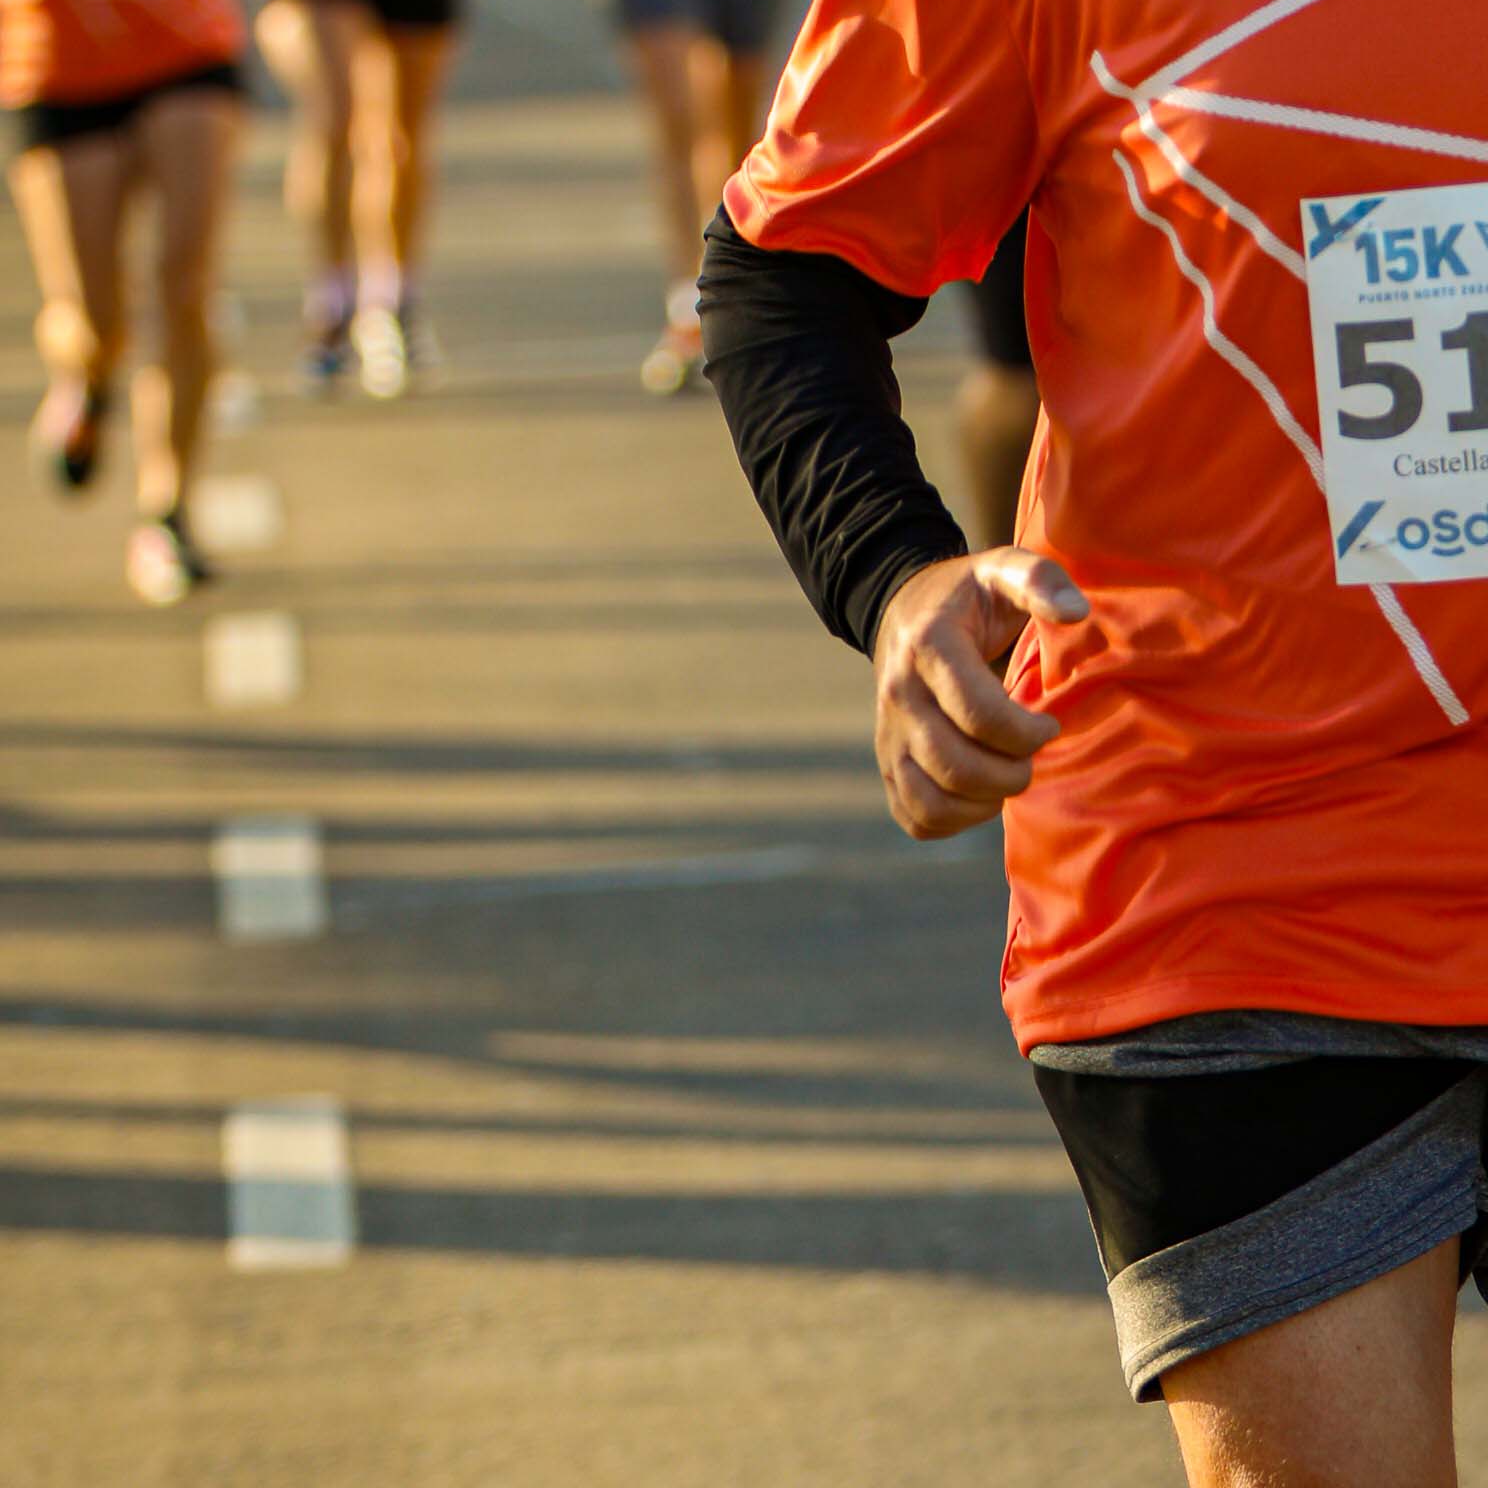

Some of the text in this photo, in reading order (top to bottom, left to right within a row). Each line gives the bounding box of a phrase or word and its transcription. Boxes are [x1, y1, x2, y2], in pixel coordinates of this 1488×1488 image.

[1354, 223, 1471, 284] 15K
[1359, 290, 1409, 304] PUERTO
[1415, 288, 1455, 300] NORTE
